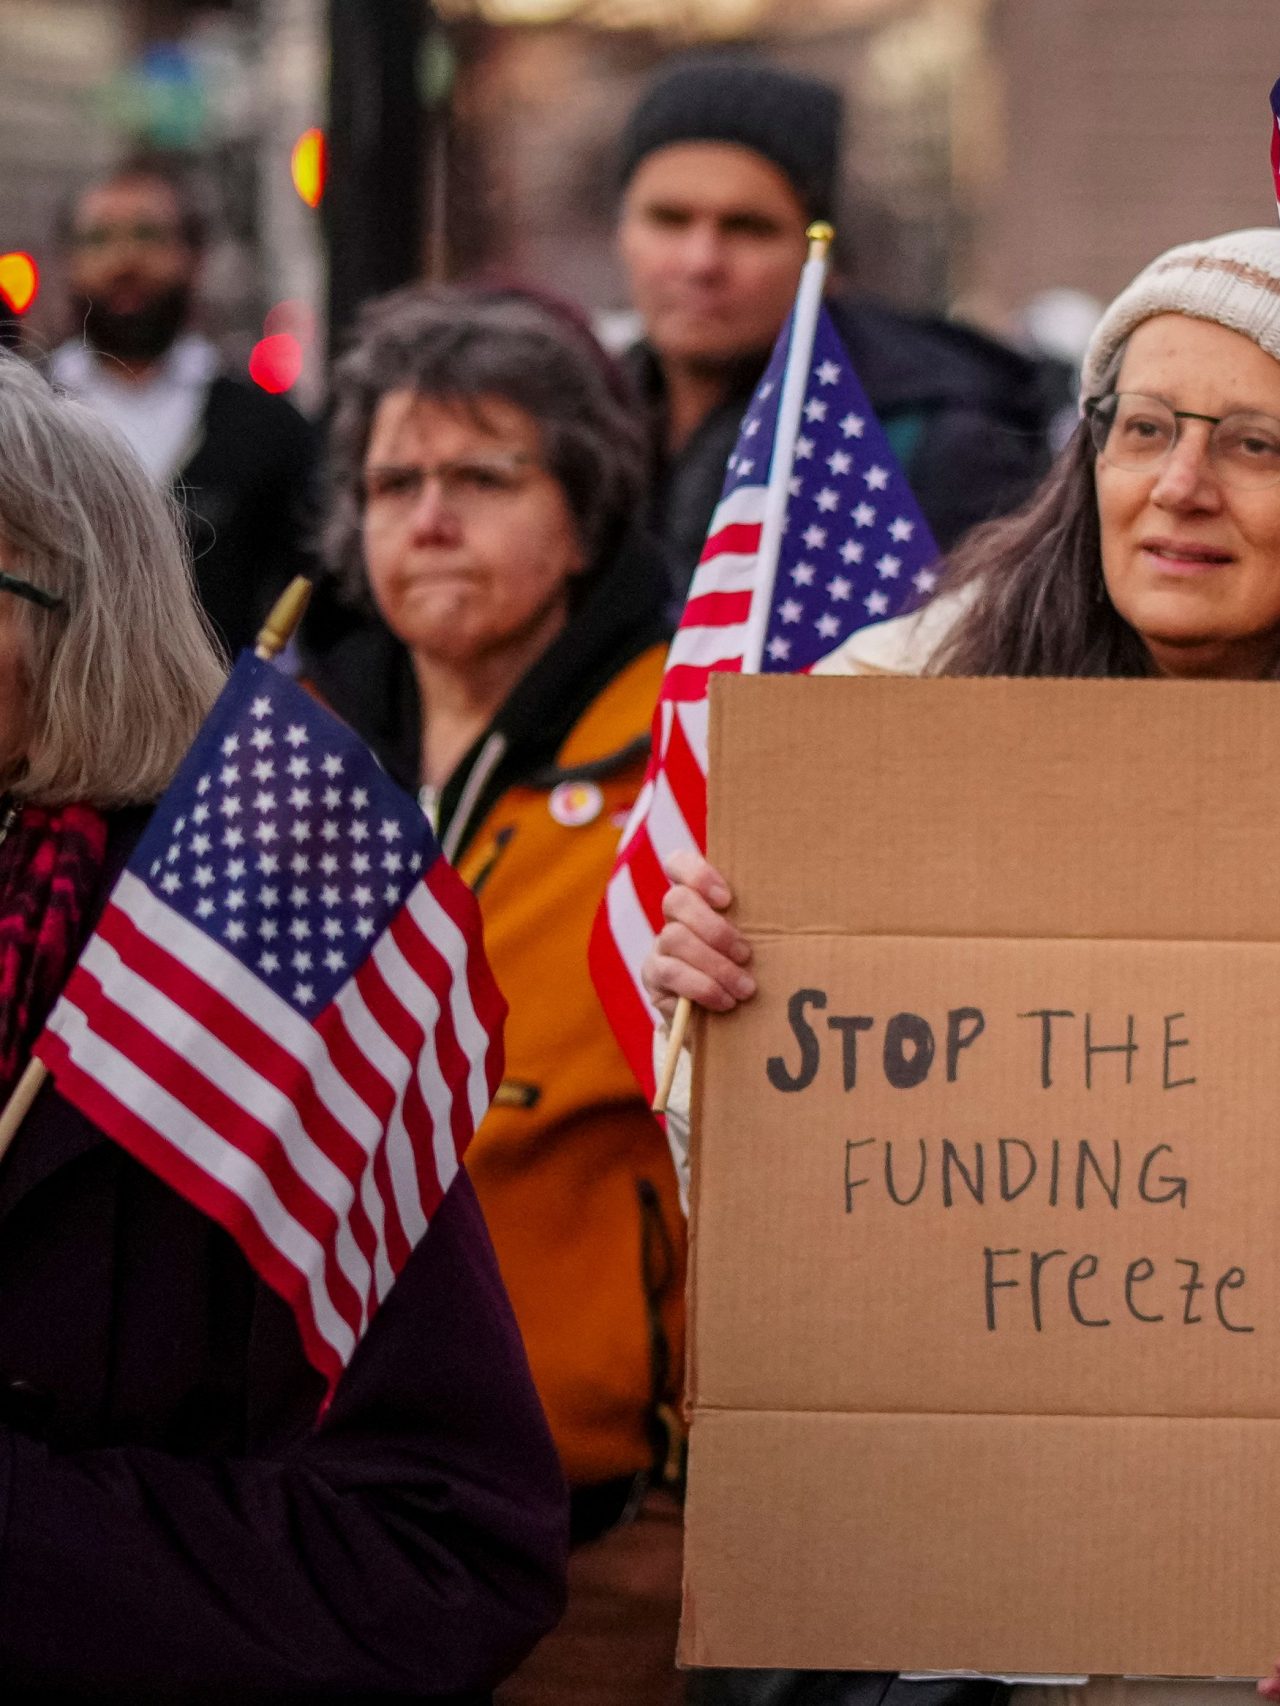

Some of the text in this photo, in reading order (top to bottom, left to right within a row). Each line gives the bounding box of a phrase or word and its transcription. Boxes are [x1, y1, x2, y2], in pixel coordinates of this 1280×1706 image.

[766, 988, 1198, 1092] STOP THE
[843, 1137, 1187, 1213] FUNDING
